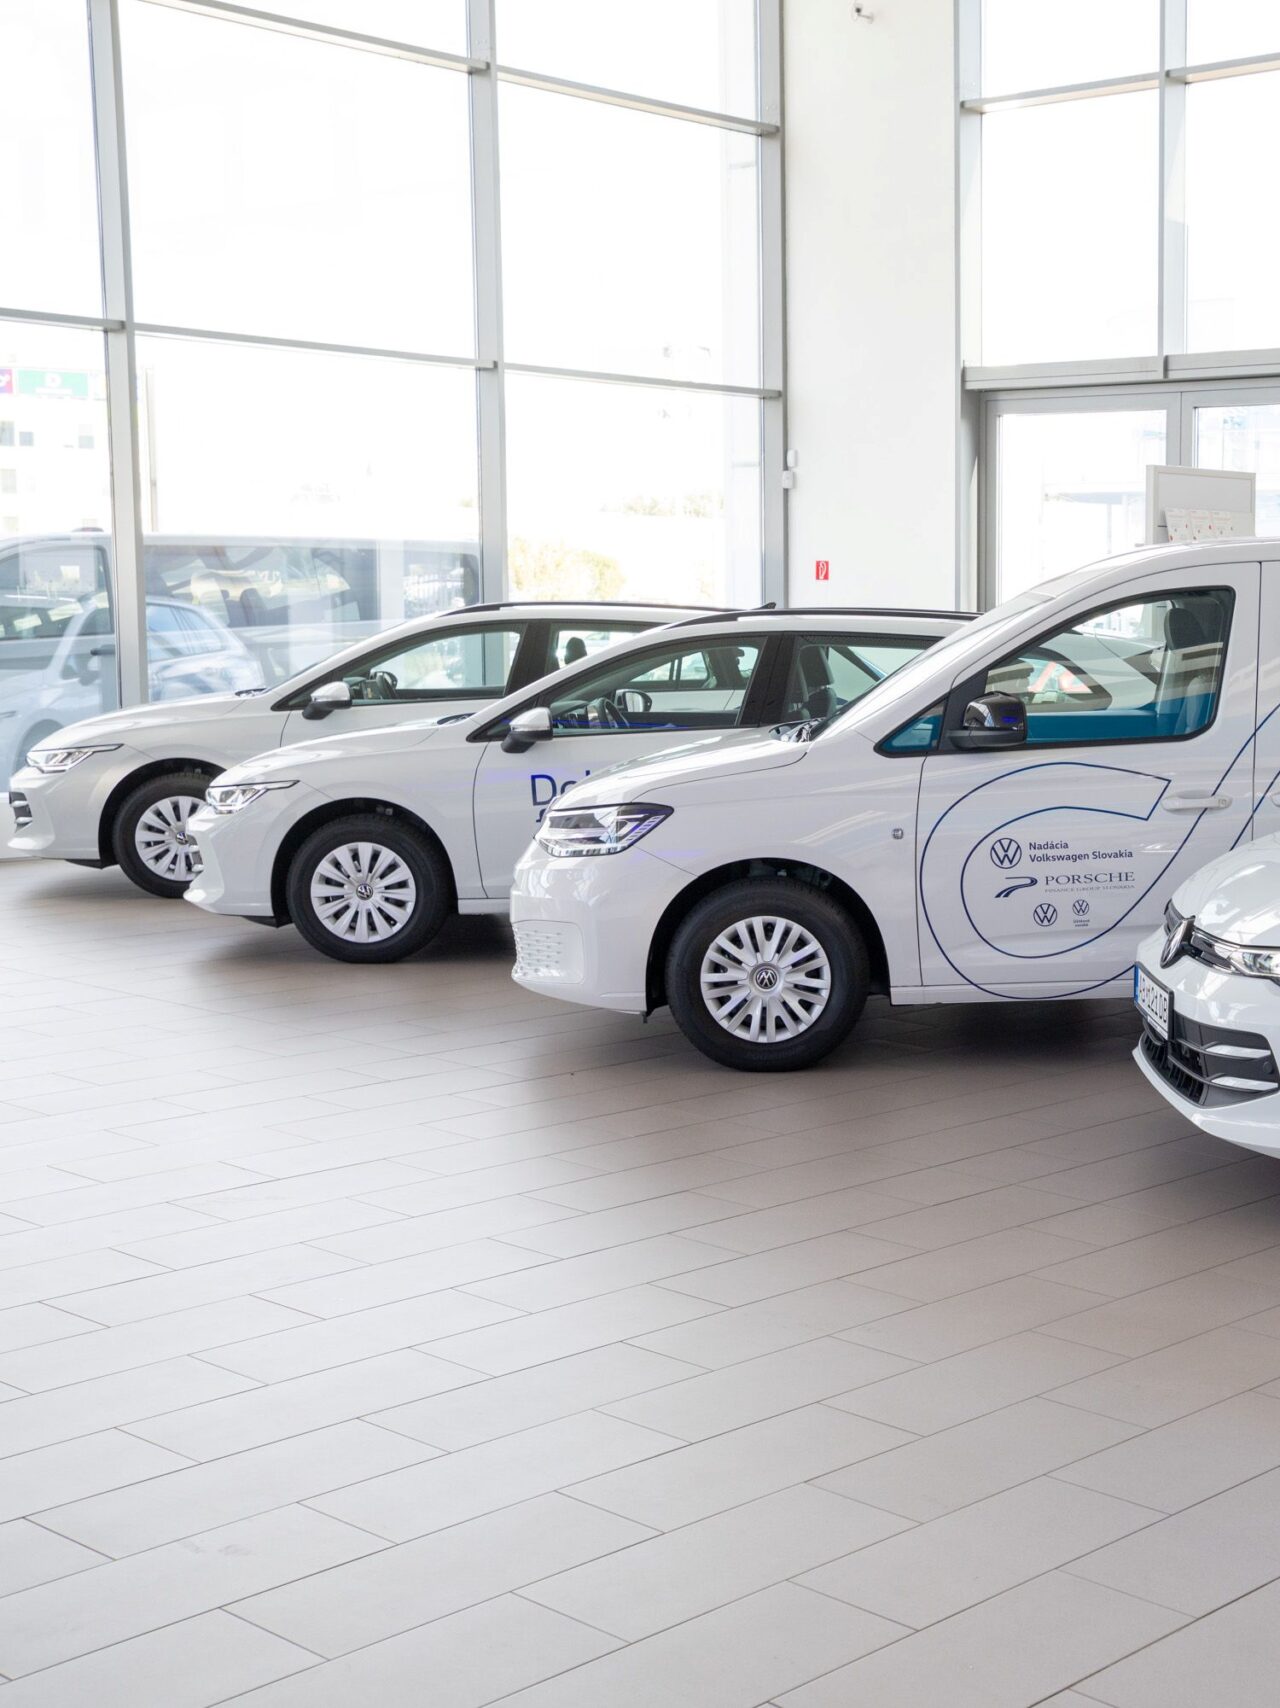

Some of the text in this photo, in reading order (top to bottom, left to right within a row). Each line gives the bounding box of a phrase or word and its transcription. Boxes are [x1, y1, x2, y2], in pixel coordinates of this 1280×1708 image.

[1029, 840, 1069, 850] Nadácia
[1029, 849, 1134, 863] Volkswagen Slovakia
[1044, 872, 1135, 886] PORSCHE
